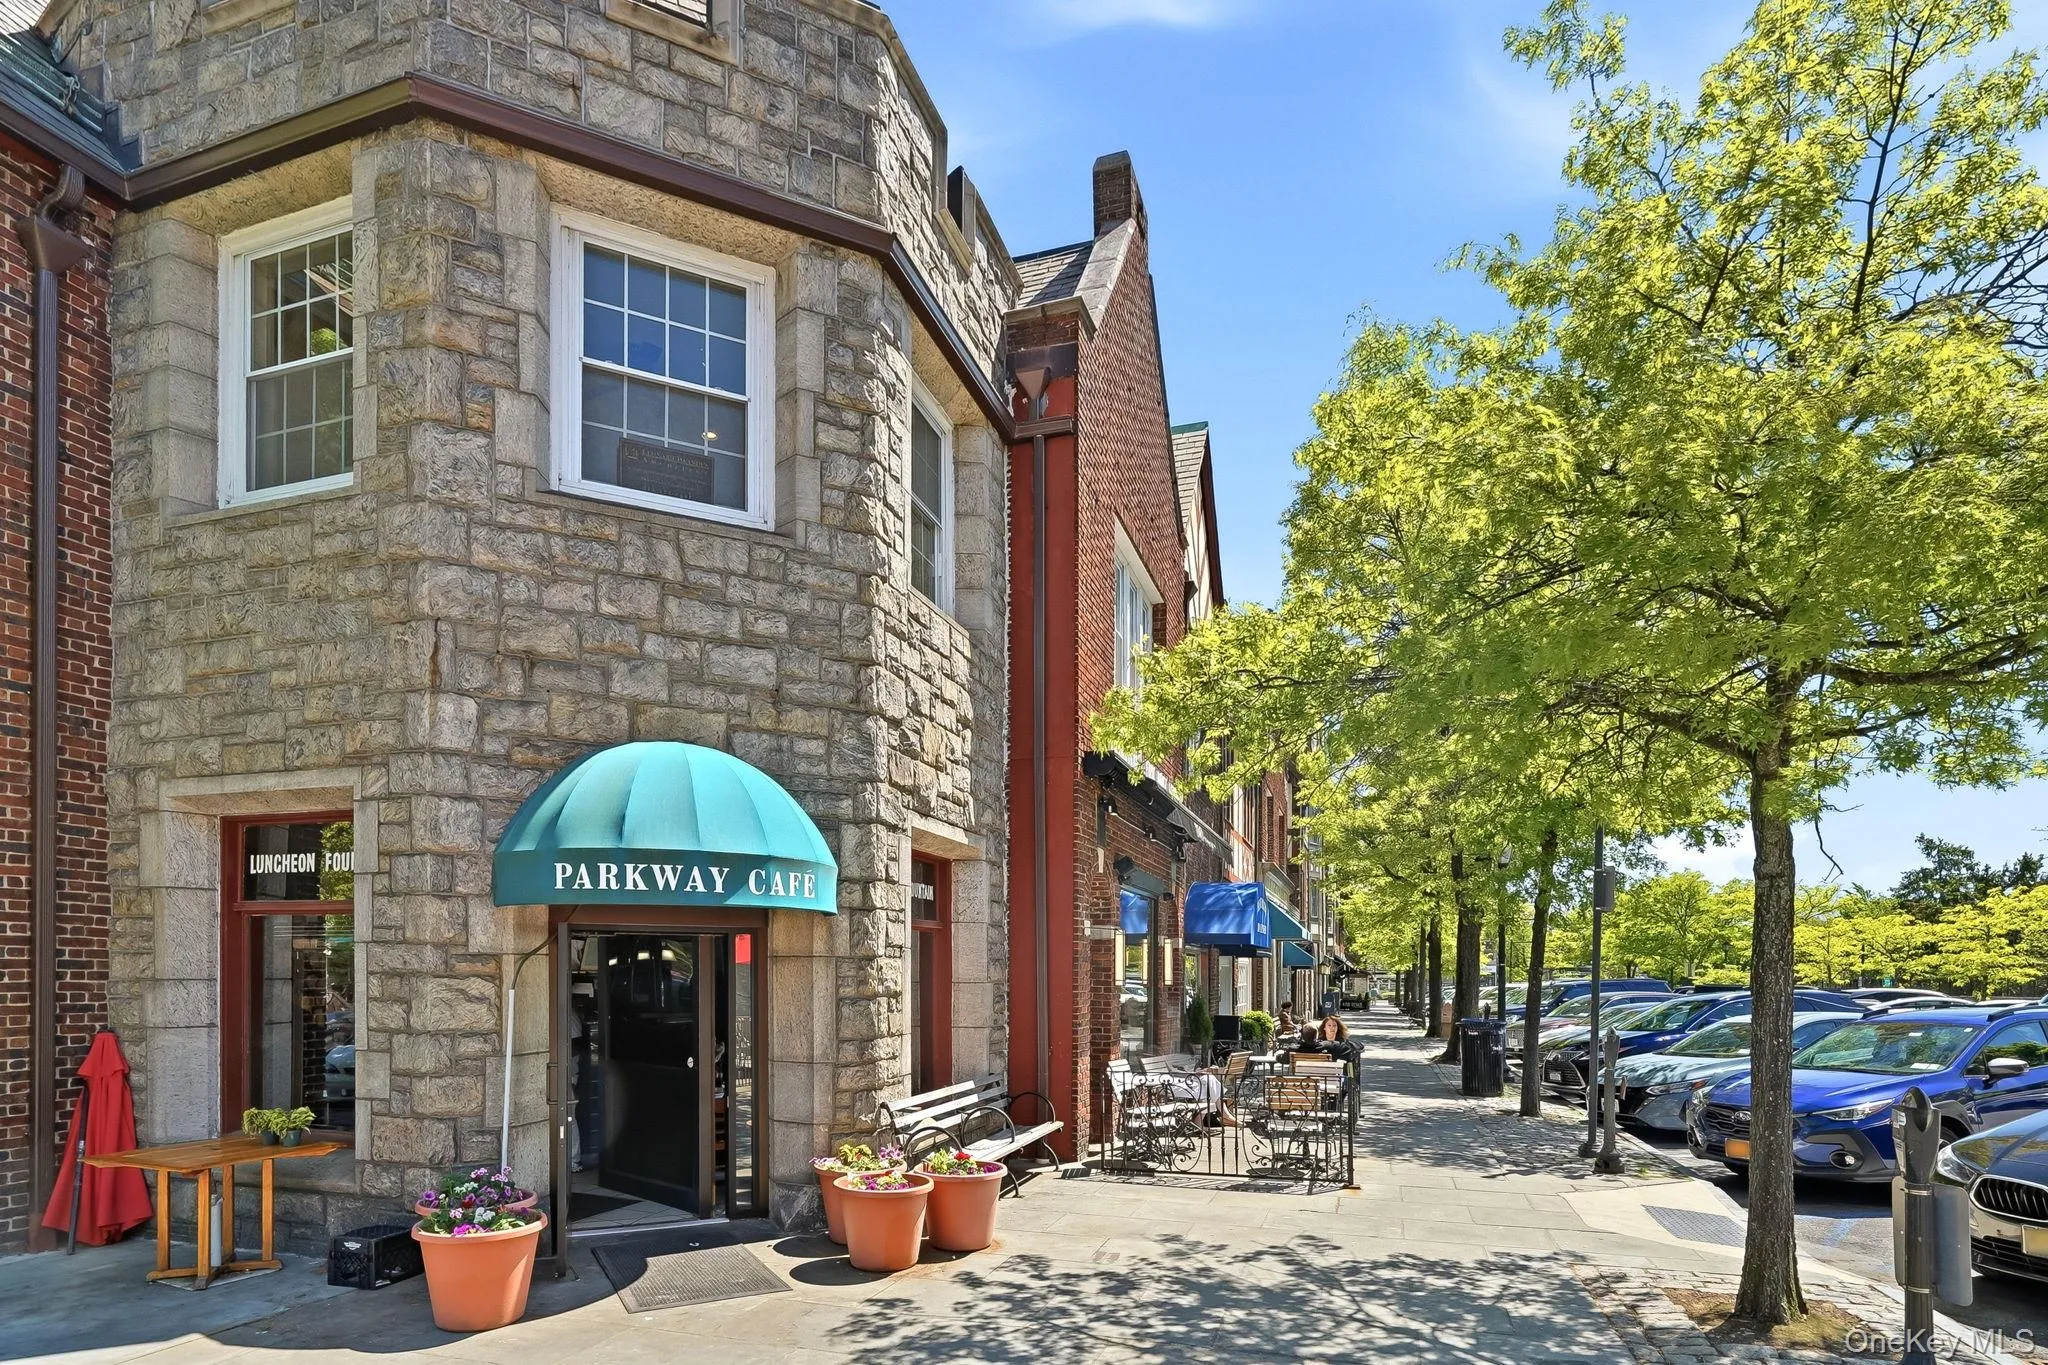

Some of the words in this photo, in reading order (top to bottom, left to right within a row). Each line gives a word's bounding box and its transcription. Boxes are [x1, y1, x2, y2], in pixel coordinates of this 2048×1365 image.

[250, 853, 316, 874] LUNCHEON
[554, 862, 730, 893] PARKWAY
[748, 868, 816, 899] CAFÉ
